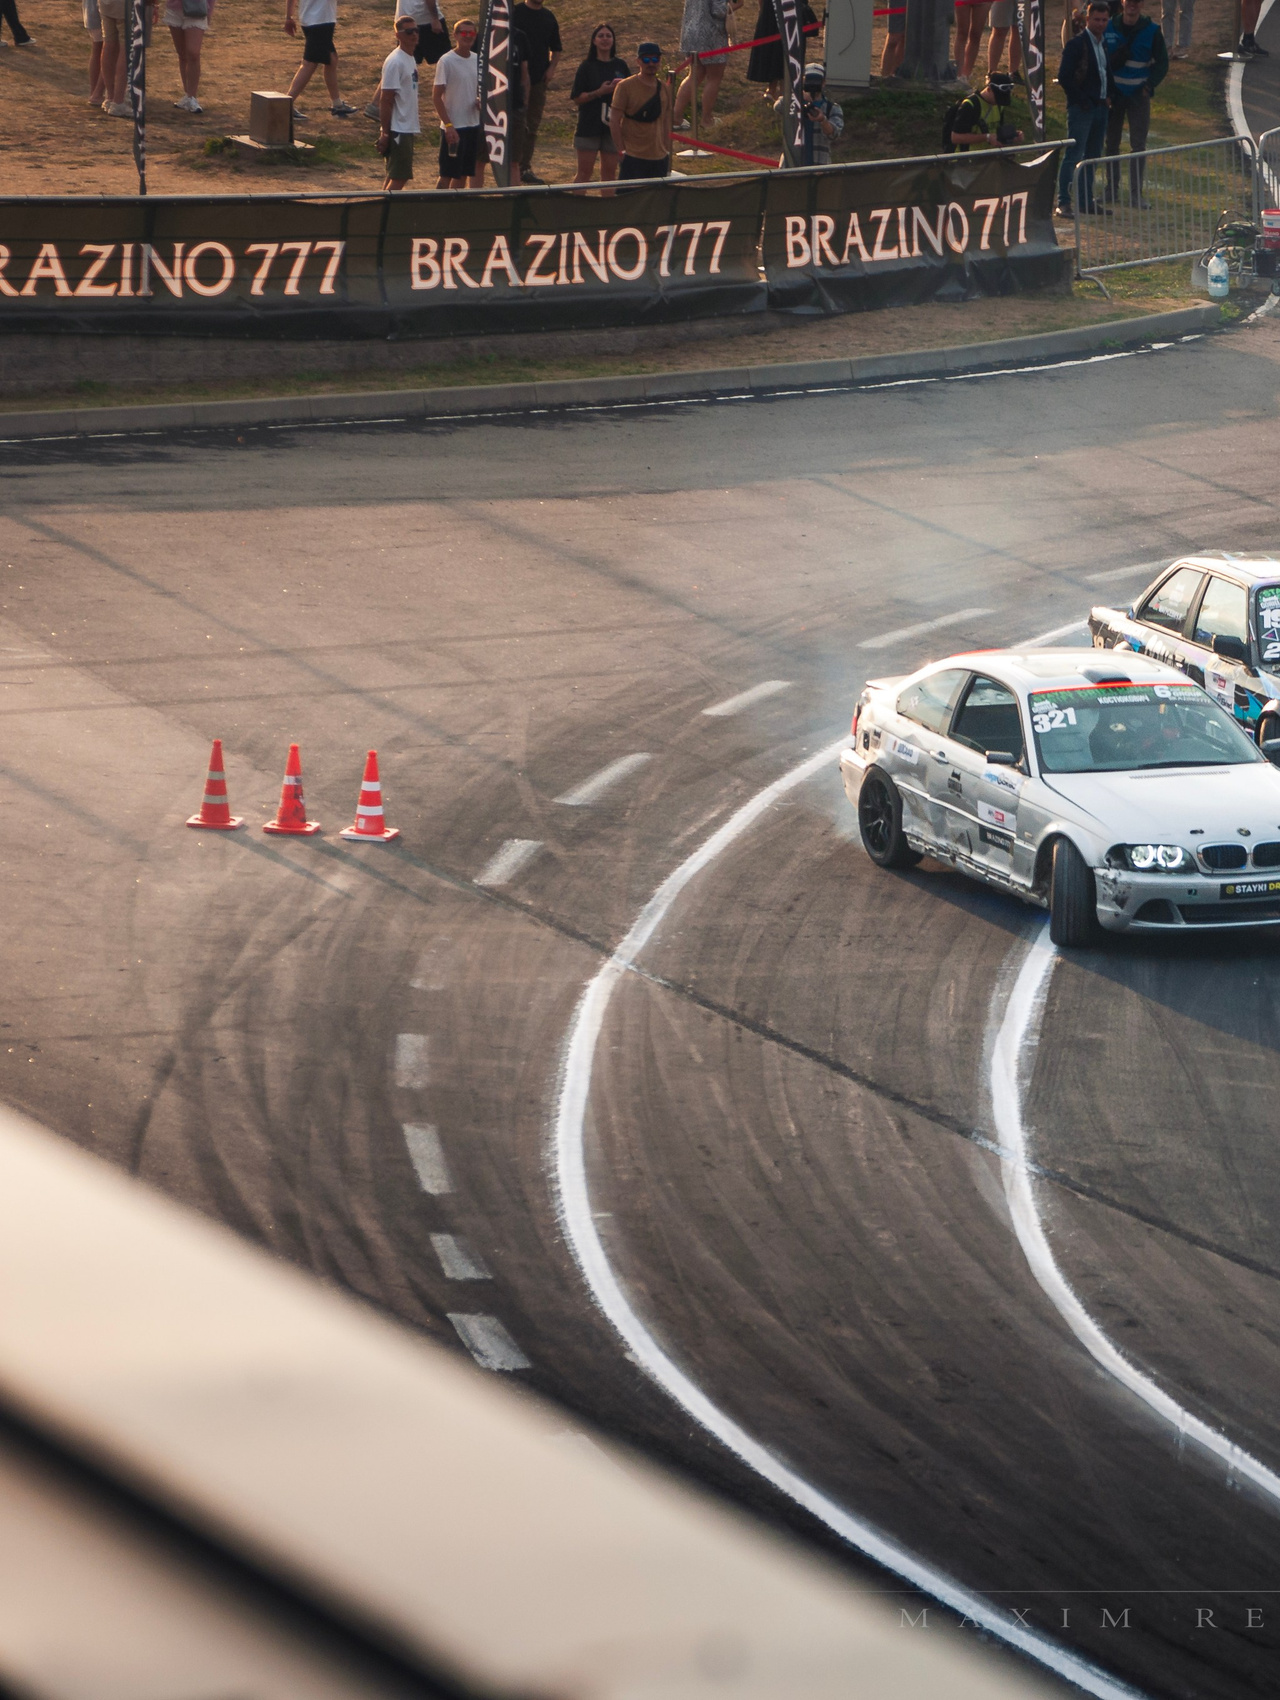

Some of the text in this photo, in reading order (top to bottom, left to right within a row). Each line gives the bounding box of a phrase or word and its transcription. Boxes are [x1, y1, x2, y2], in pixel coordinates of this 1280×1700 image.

[1153, 685, 1171, 698] 6
[1032, 707, 1077, 734] 321
[1235, 883, 1267, 894] STAYKI
